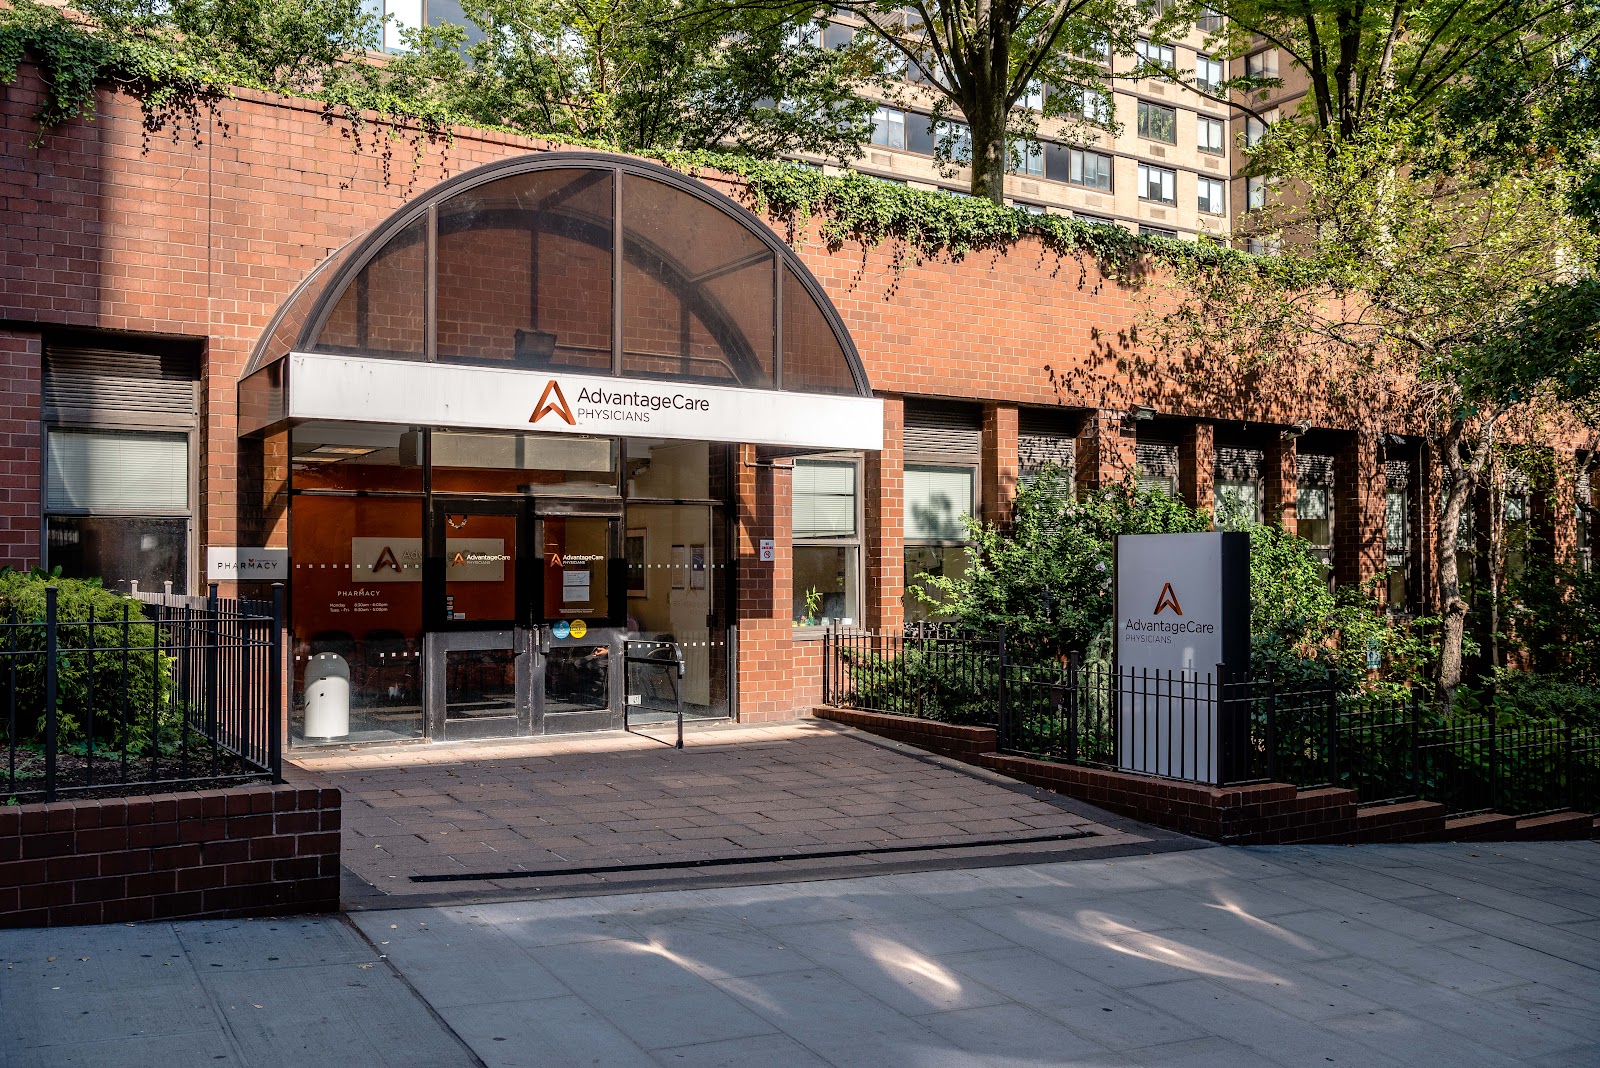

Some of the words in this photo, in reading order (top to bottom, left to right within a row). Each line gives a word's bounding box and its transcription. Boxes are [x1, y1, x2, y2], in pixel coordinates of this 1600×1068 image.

[577, 387, 710, 411] AdvantageCare
[577, 408, 650, 423] PHYSICIANS
[217, 562, 278, 570] PHARMACY
[1125, 618, 1214, 635] AdvantageCare
[1125, 633, 1172, 644] PHYSICIANS
